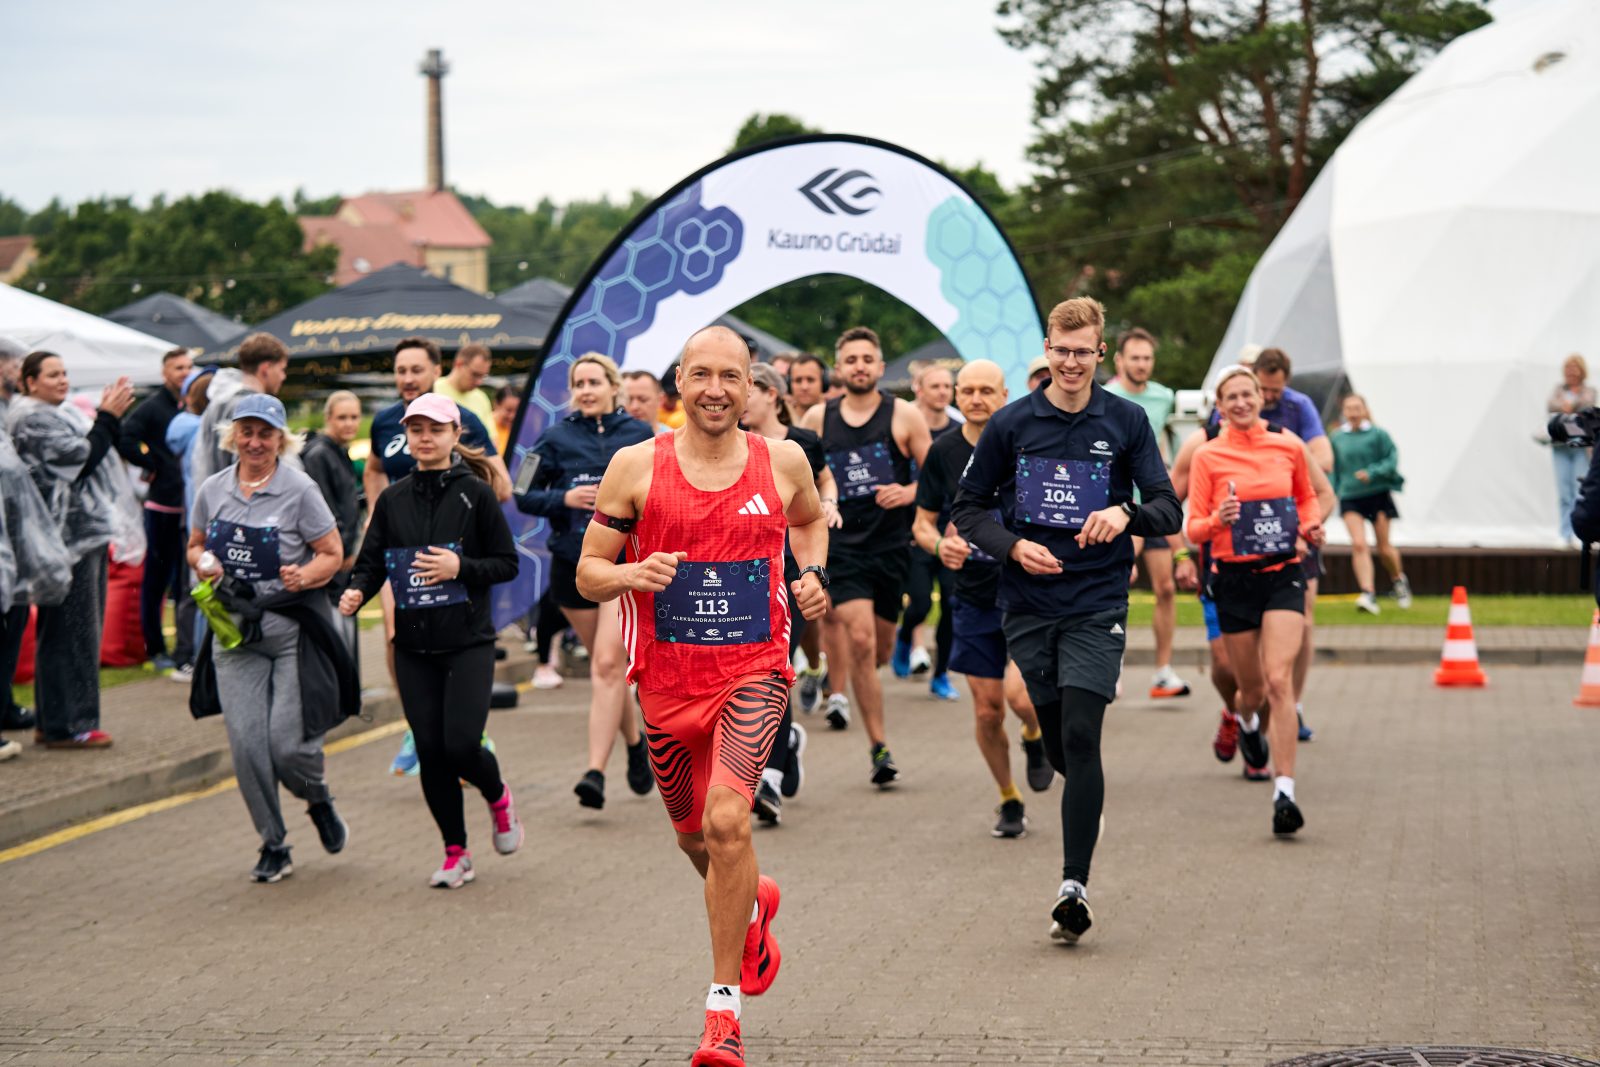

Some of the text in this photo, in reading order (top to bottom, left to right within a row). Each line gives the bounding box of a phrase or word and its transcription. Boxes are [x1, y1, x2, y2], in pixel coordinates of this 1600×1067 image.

[767, 228, 902, 255] Kauno Grūdai
[1044, 488, 1076, 504] 104
[227, 548, 252, 562] 022
[695, 599, 729, 615] 113
[672, 614, 752, 623] ALEKSANDRAS SOROKINAS
